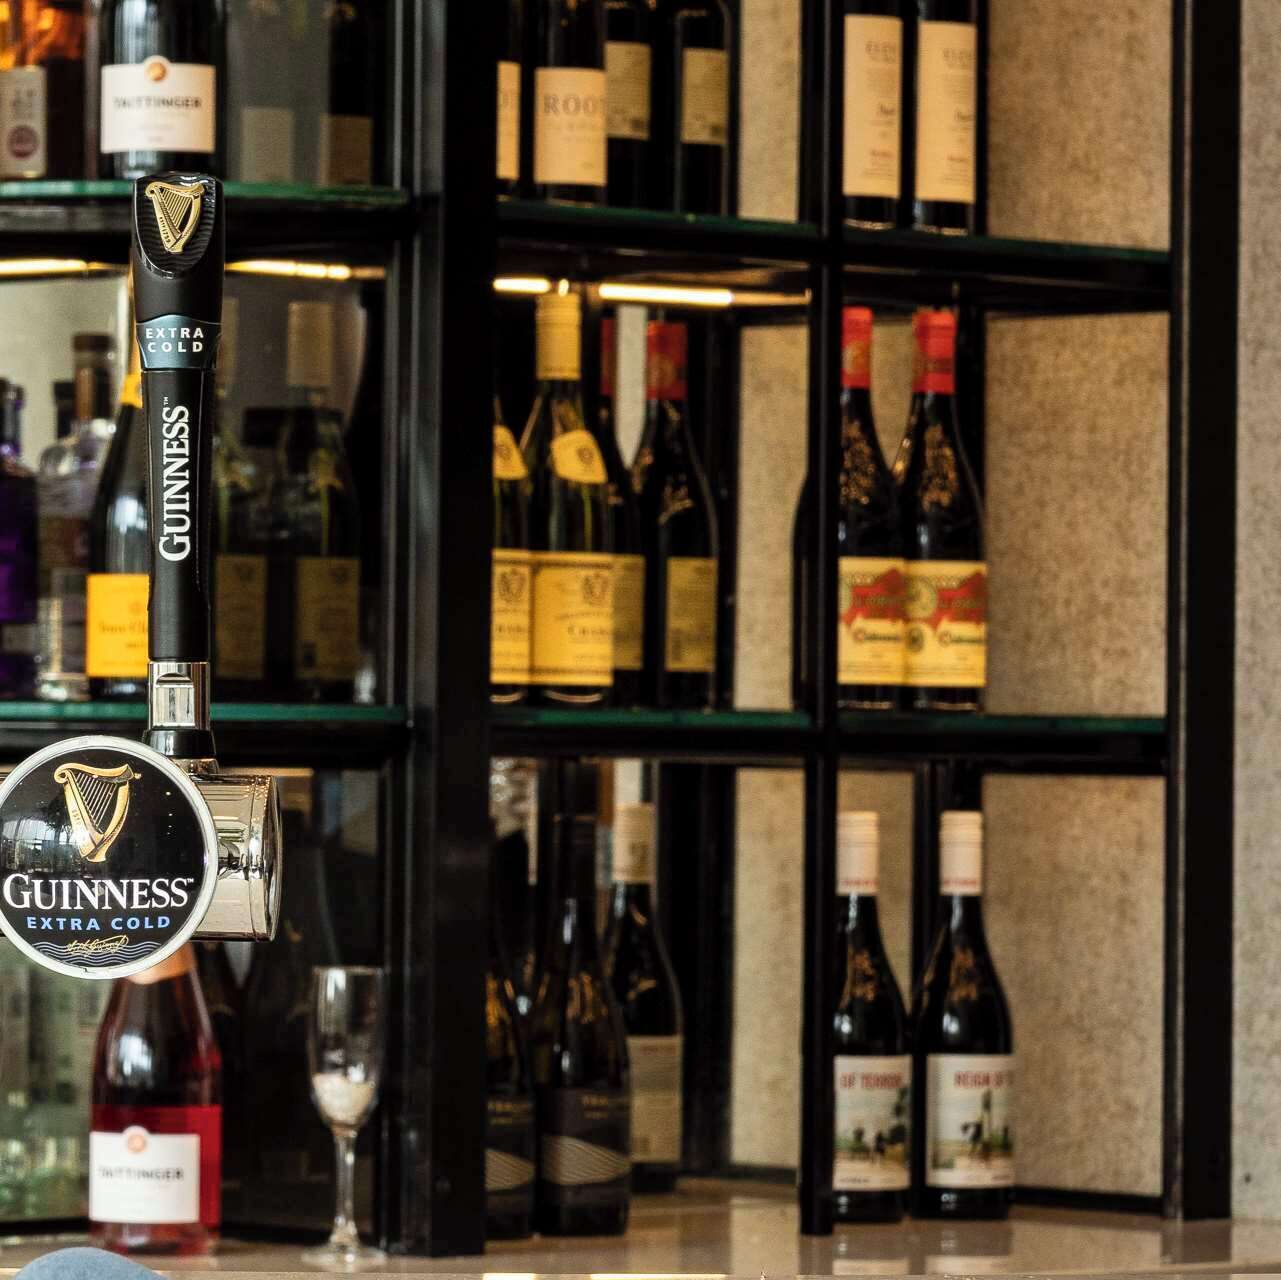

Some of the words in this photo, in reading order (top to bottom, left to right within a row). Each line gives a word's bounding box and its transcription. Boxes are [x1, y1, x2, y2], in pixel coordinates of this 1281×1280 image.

[145, 327, 205, 340] EXTRA
[147, 341, 204, 354] COLD
[158, 404, 192, 563] GUINNESS
[2, 872, 188, 911] GUINNESS
[26, 916, 100, 931] EXTRA
[110, 915, 171, 931] COLD
